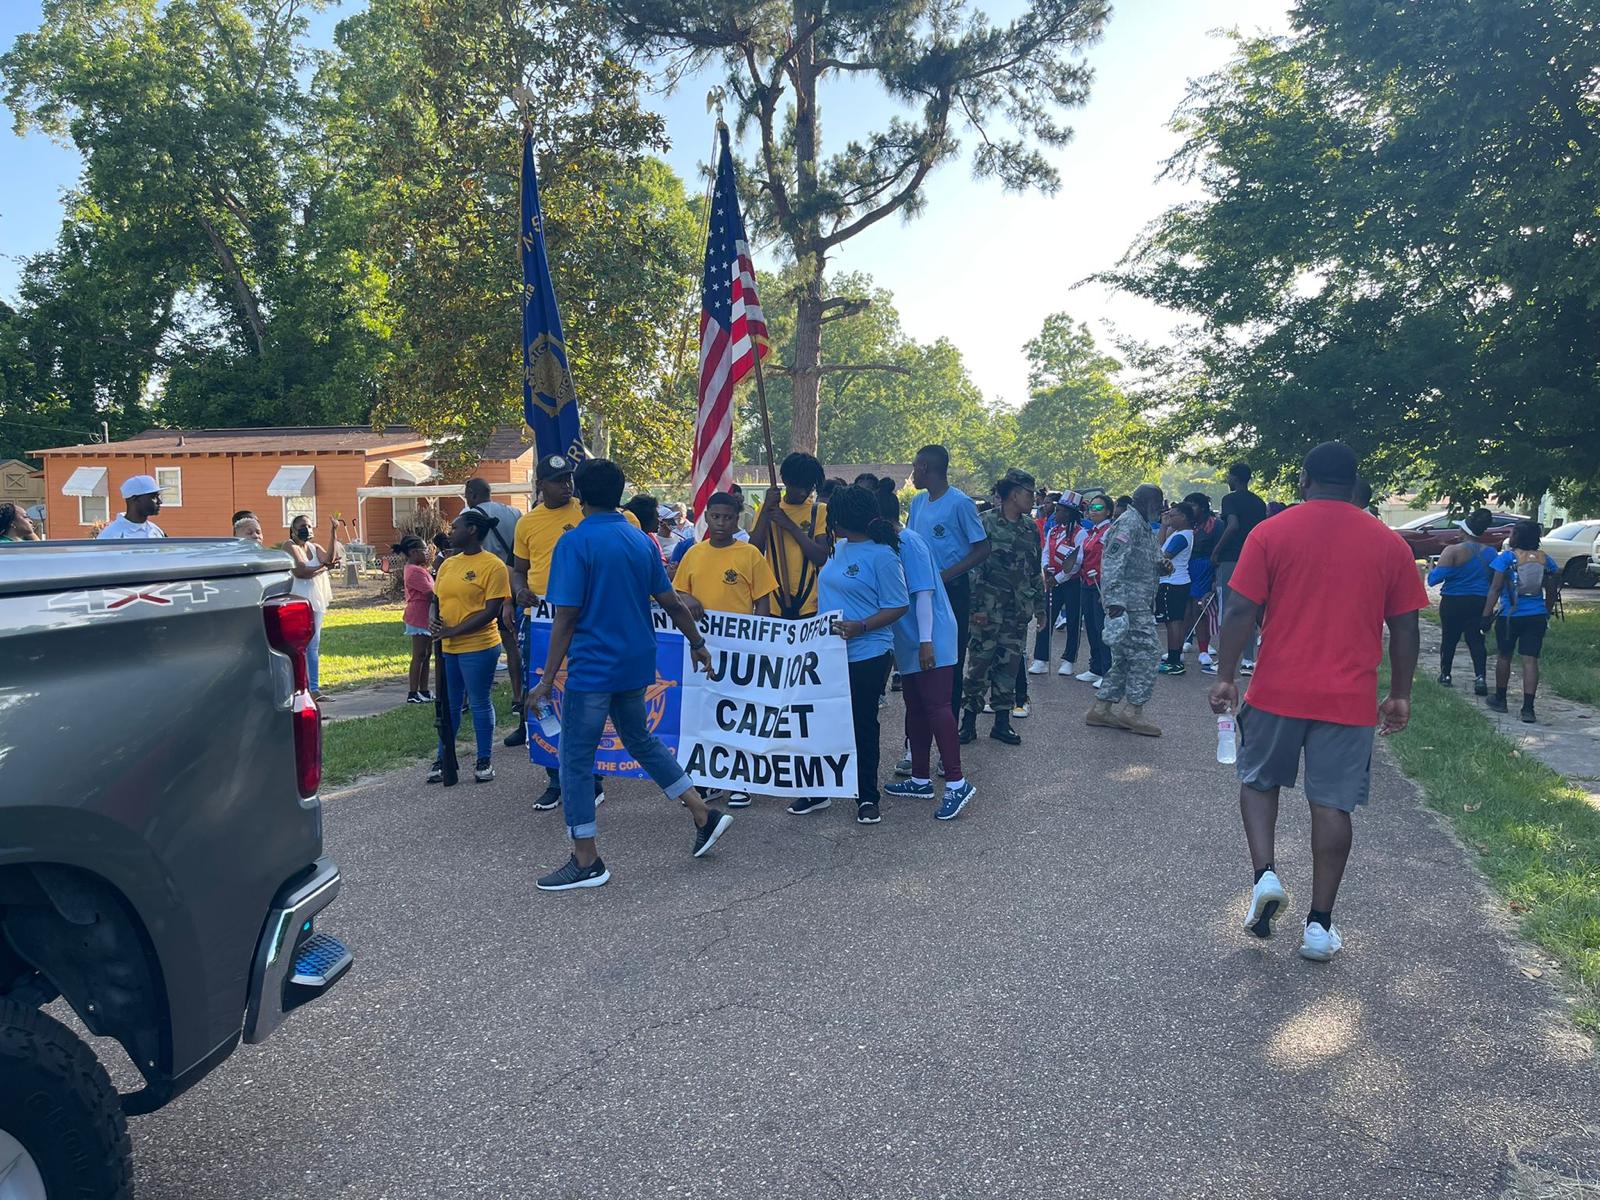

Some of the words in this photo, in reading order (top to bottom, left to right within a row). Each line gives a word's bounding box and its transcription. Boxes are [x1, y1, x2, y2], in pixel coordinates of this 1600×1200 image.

[700, 613, 796, 645] SHERIFF'S
[800, 614, 839, 643] OFFICE
[709, 651, 821, 689] JUNIOR
[716, 699, 814, 738] CADET
[597, 761, 617, 771] THE
[684, 743, 850, 787] ACADEMY
